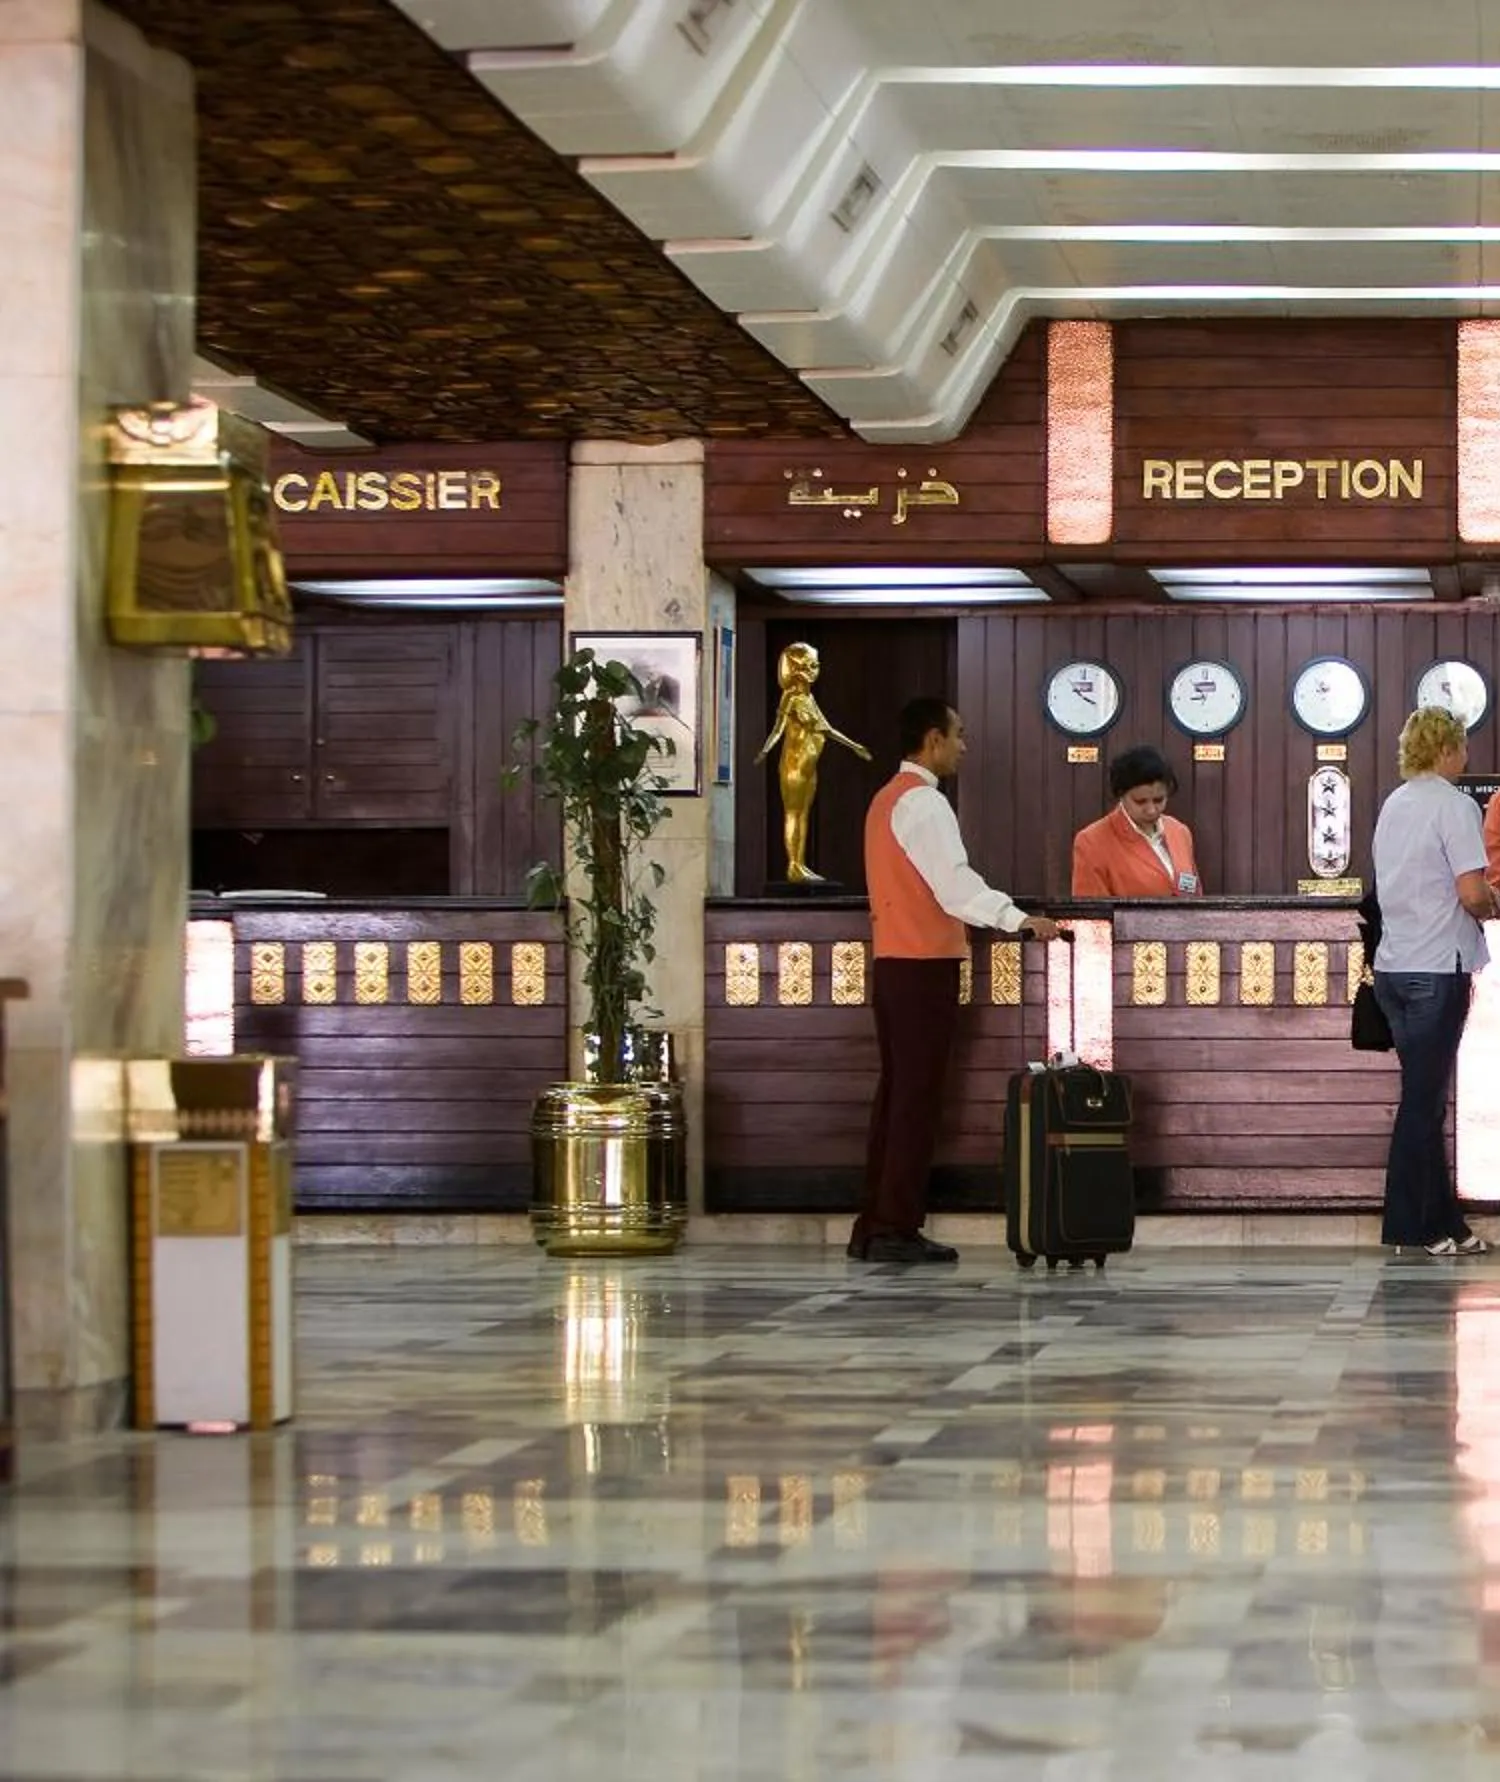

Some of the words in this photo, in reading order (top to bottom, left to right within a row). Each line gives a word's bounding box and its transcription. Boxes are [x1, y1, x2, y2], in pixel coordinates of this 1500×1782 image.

[273, 470, 502, 513] CAISSIER
[783, 467, 959, 526] خزينة
[1142, 458, 1424, 500] RECEPTION
